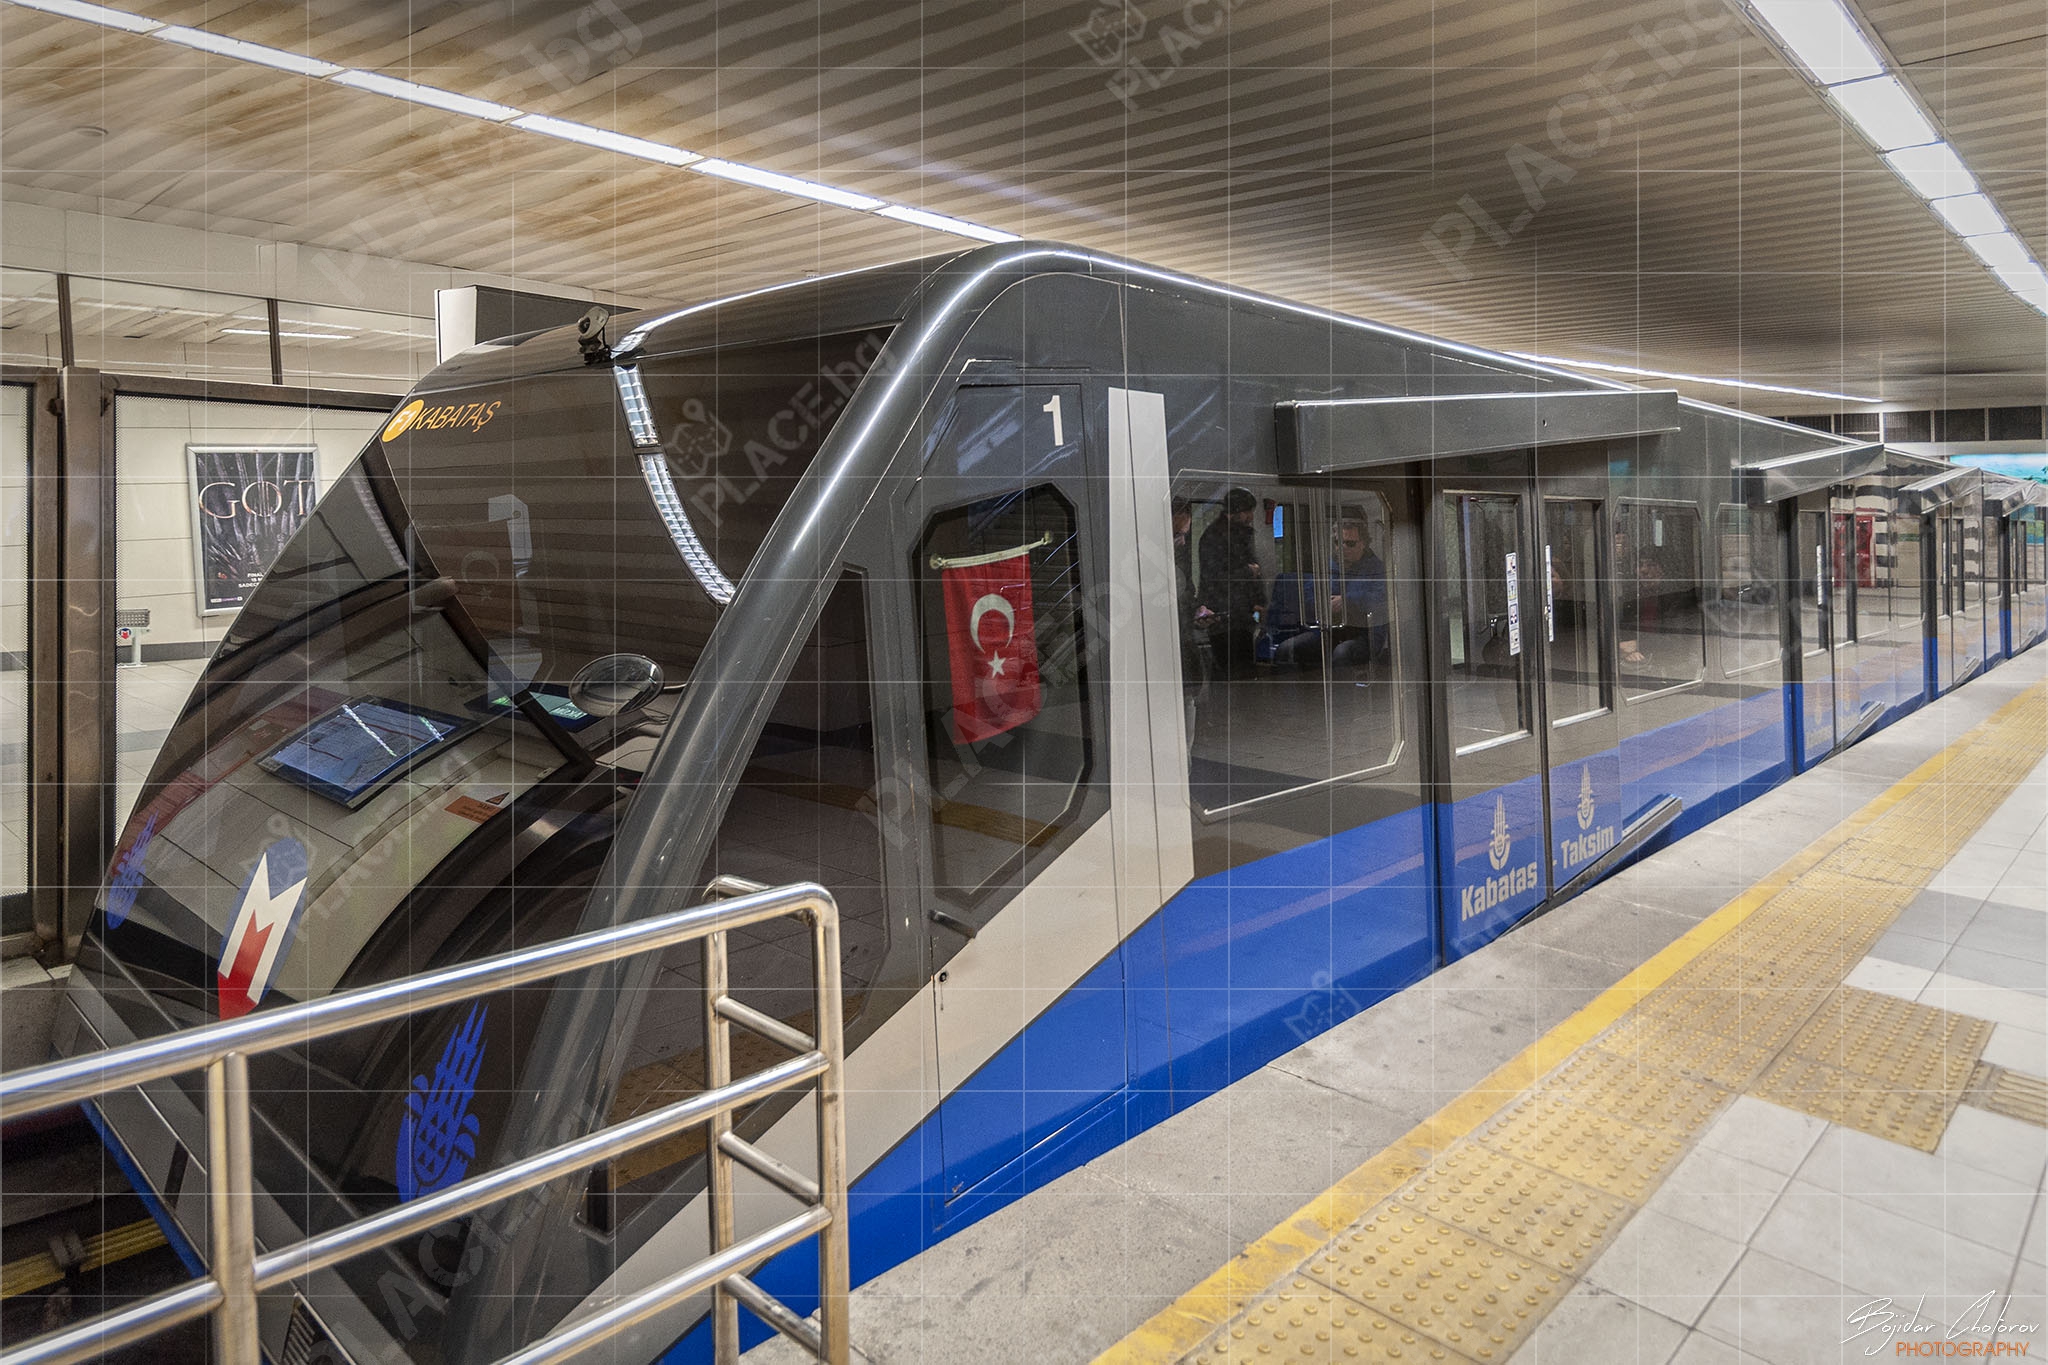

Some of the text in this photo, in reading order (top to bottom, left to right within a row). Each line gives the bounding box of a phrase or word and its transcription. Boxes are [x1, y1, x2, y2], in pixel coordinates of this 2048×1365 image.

[409, 401, 502, 432] KABATAŞ
[1043, 395, 1064, 446] 1
[199, 480, 315, 519] GOT
[1561, 826, 1615, 869] Taksim
